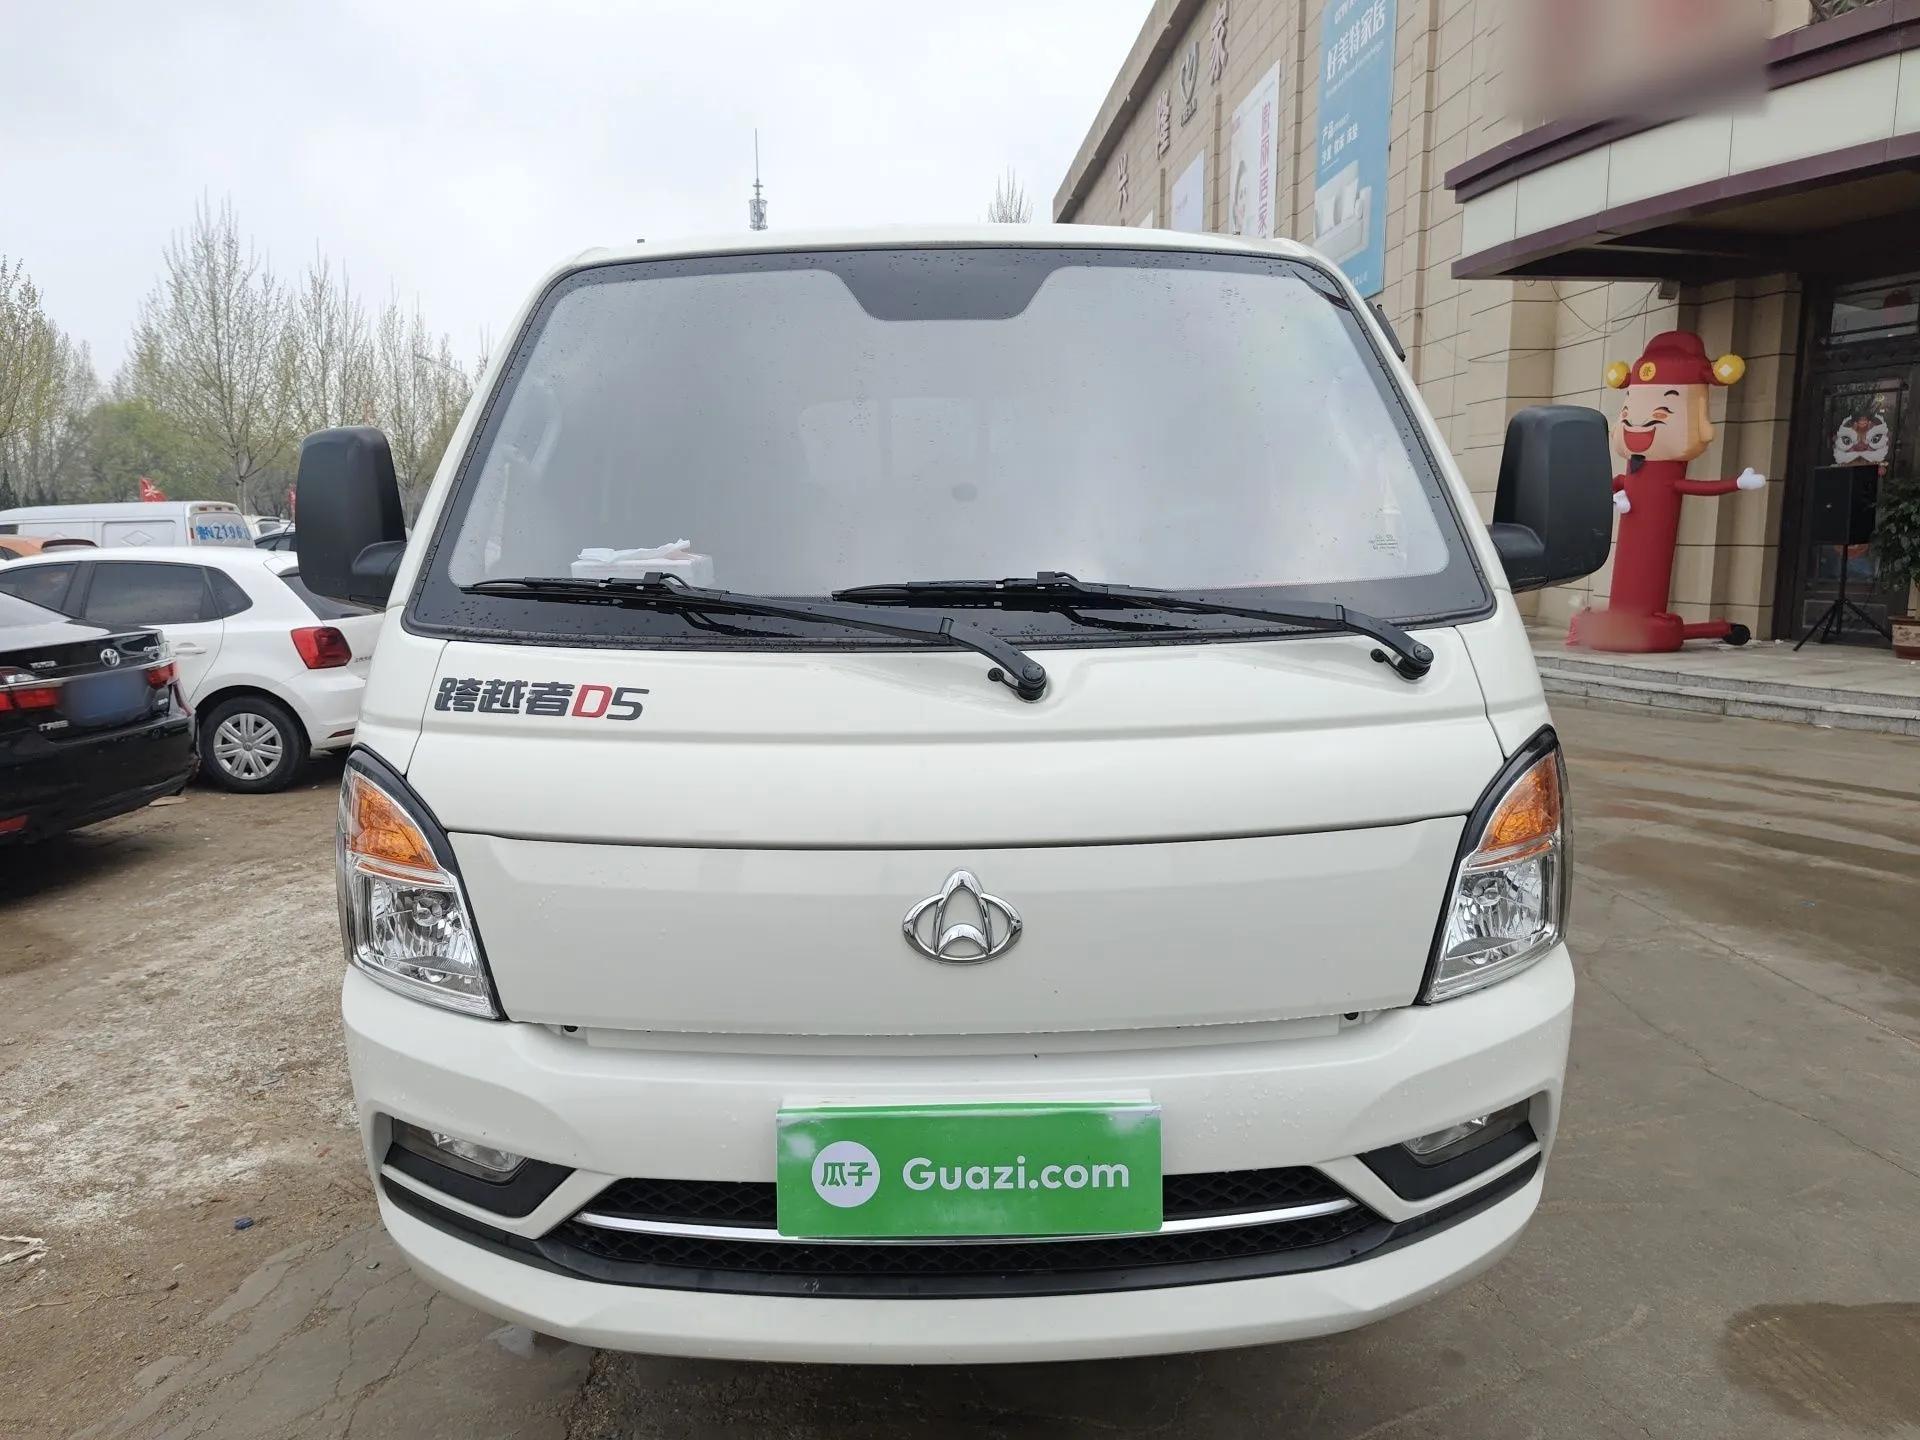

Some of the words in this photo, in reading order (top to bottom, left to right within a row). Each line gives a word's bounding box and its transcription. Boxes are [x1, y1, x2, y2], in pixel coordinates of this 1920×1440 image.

[434, 677, 650, 721] 跨越者D5
[821, 1162, 873, 1187] 瓜子
[902, 1156, 1130, 1191] Guazi.com
